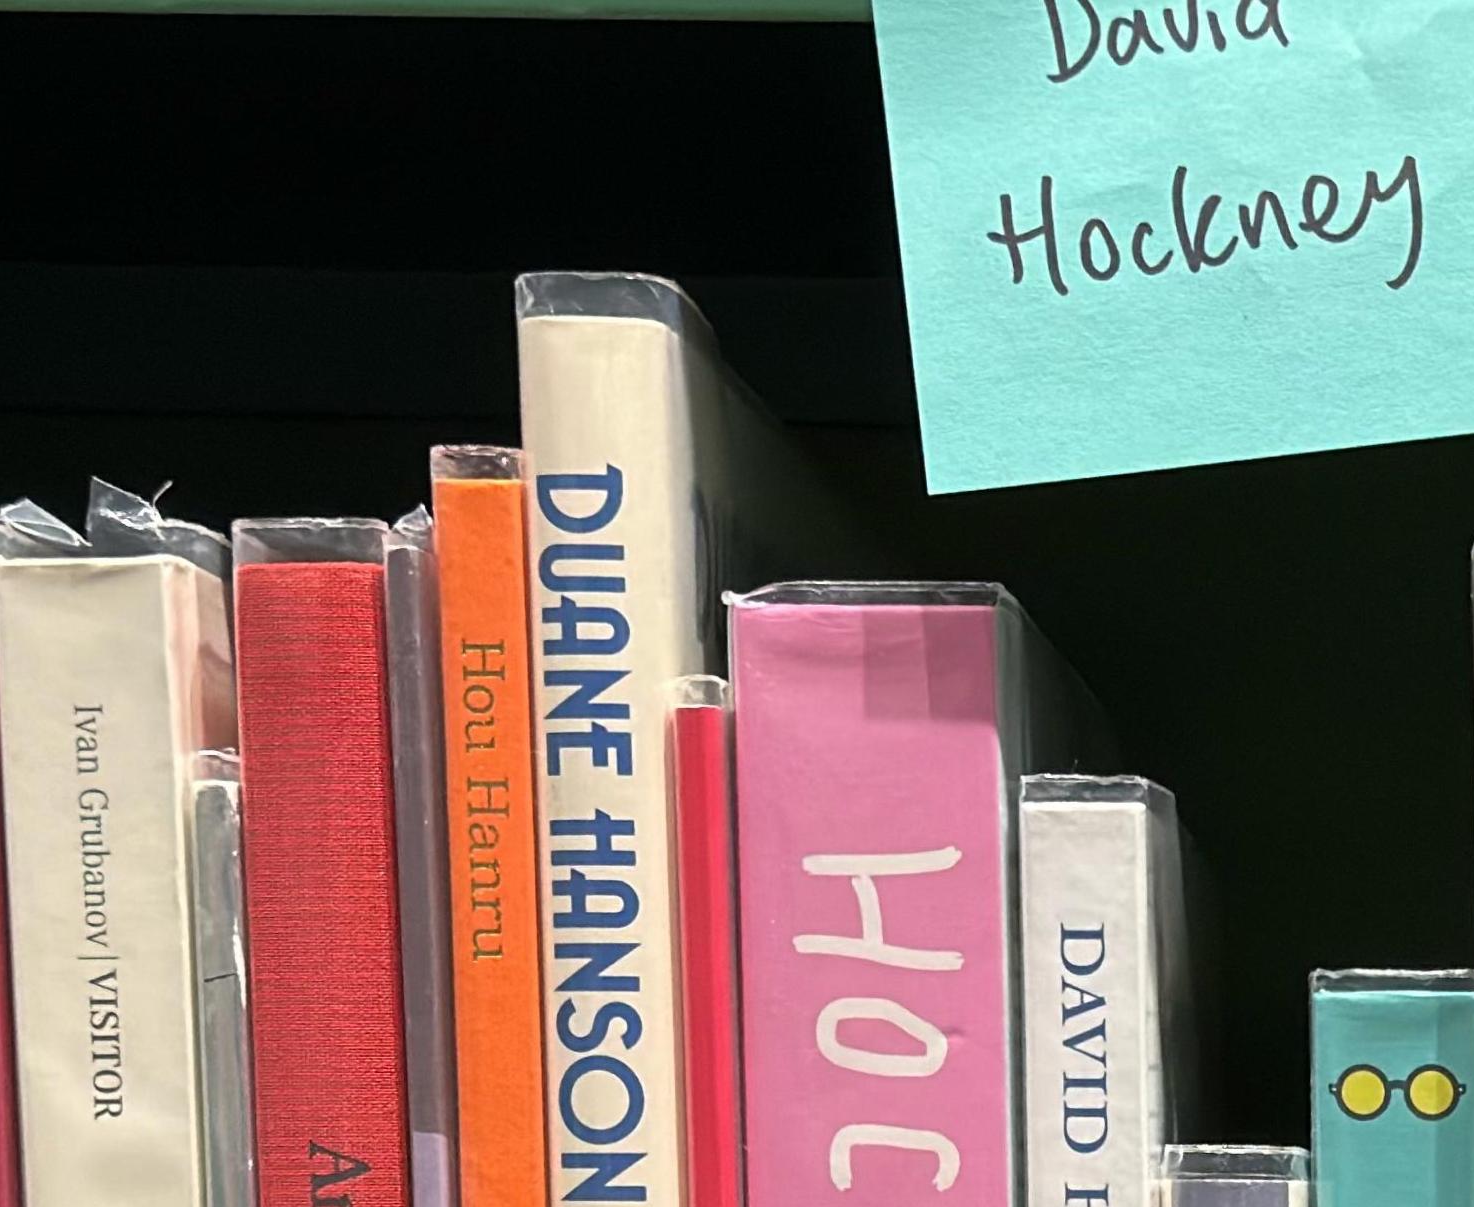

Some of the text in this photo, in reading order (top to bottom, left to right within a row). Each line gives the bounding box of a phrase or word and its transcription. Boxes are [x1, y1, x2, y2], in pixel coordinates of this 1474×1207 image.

[987, 155, 1424, 297] Hockney
[73, 703, 103, 774] Ivan
[460, 638, 510, 962] Hou Hanru
[77, 787, 111, 949] Grubanov
[536, 463, 648, 1202] DUANE HANSON
[88, 967, 124, 1121] VISITOR
[1060, 922, 1108, 1154] DAVID
